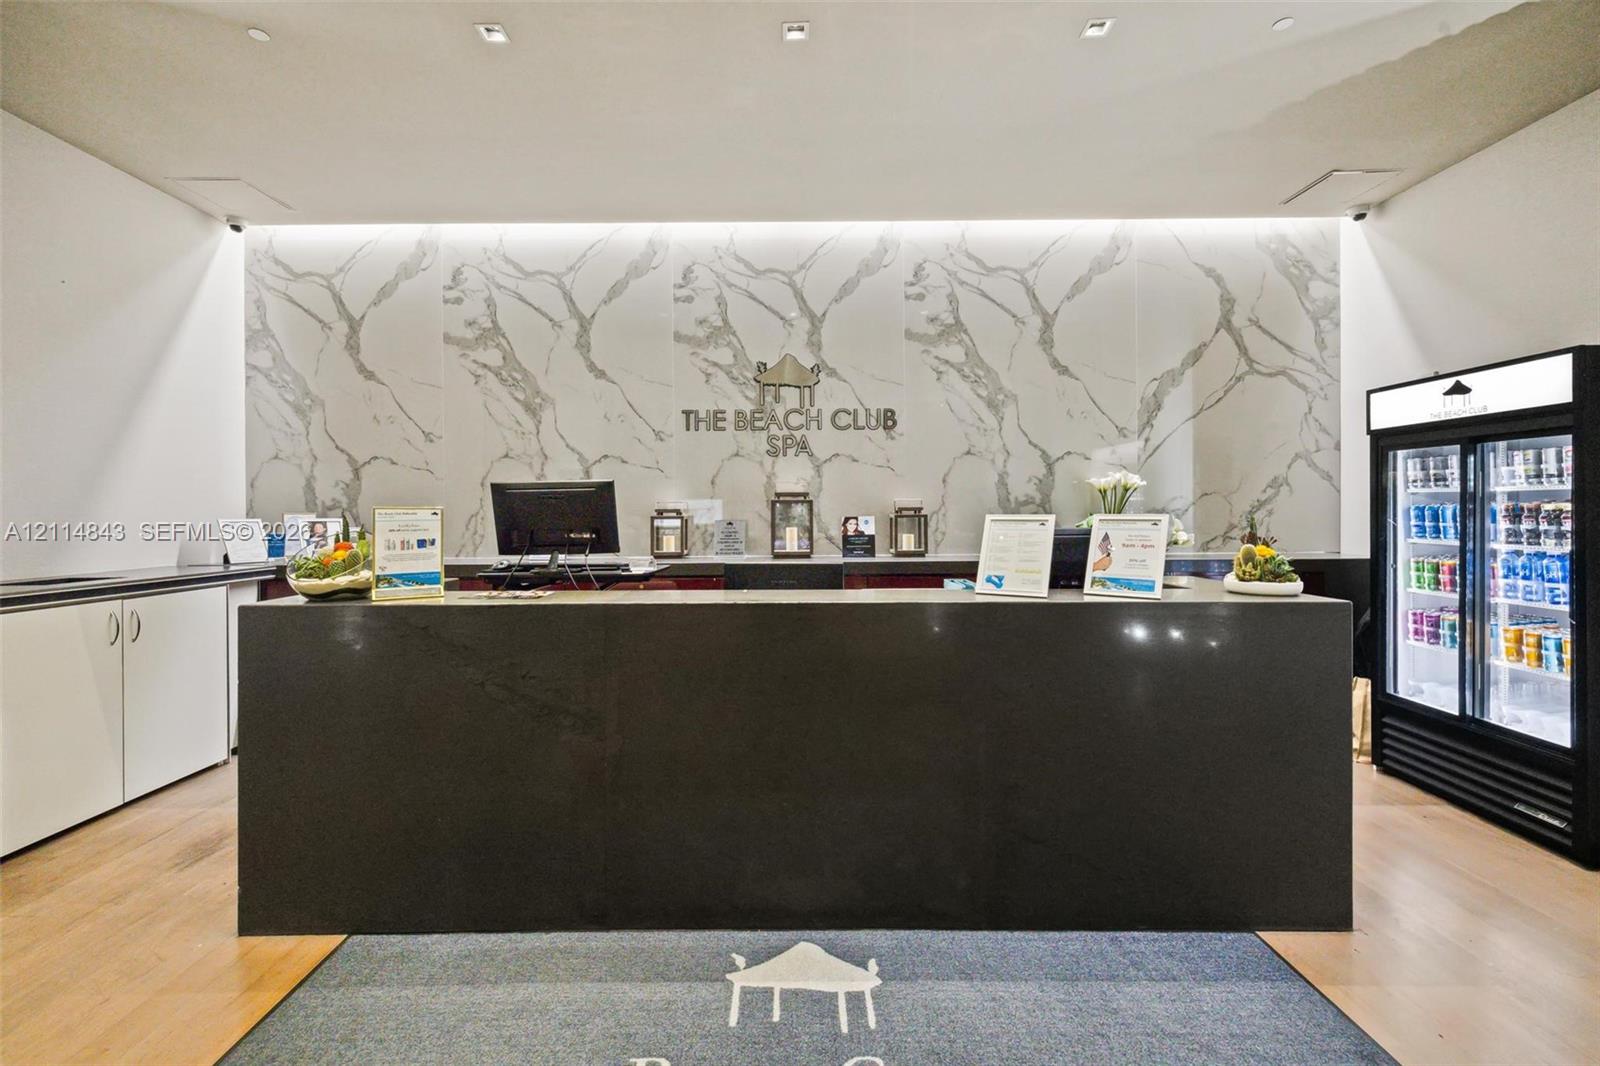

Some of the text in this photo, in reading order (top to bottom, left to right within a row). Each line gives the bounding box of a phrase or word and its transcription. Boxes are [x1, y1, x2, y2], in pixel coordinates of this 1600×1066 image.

[681, 408, 898, 431] THE BEACH CLUB
[1444, 408, 1467, 418] BEACH
[1469, 405, 1488, 414] CLUB
[766, 434, 814, 457] SPA
